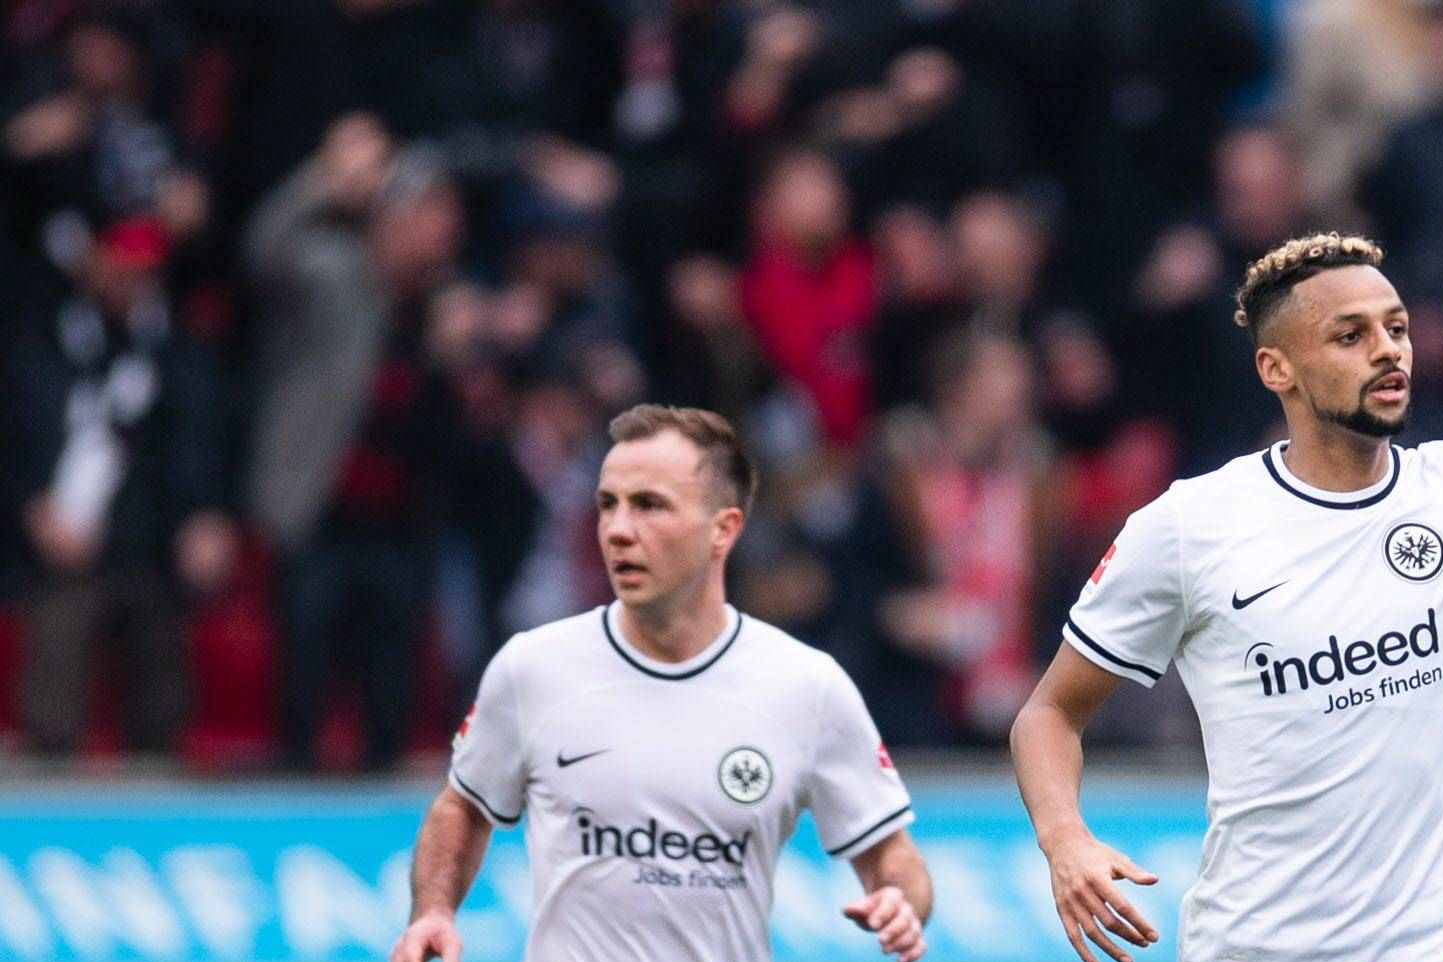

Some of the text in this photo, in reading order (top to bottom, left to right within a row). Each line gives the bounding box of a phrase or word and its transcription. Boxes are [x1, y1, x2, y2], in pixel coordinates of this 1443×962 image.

[1245, 607, 1441, 697] indeed
[1323, 665, 1443, 715] Jobs finden
[572, 807, 753, 868] indeed
[632, 865, 683, 887] Jobs
